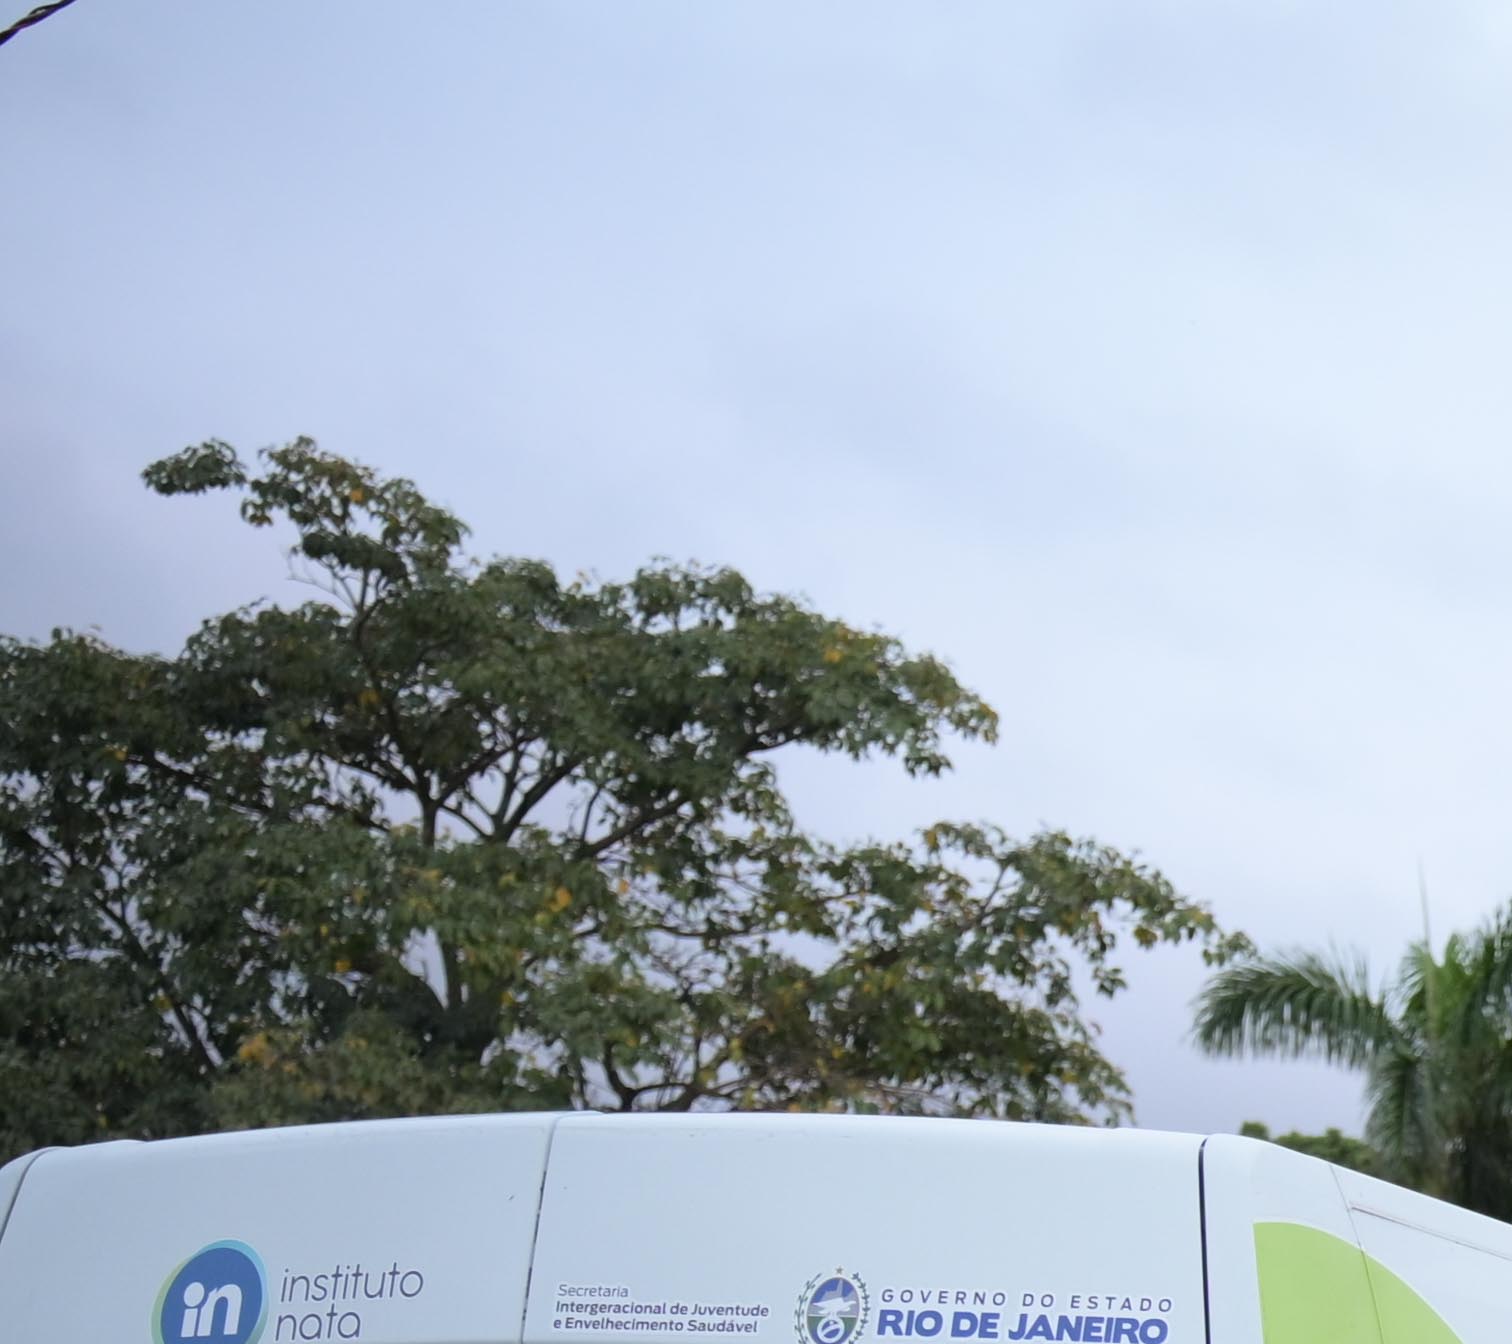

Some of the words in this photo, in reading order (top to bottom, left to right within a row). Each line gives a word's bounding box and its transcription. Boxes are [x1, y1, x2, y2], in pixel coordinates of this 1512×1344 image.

[280, 1262, 424, 1303] instituto
[557, 1285, 629, 1298] Secretaria
[555, 1300, 667, 1316] Intergeracional
[670, 1303, 688, 1315] de
[691, 1303, 770, 1317] Juventude
[881, 1288, 1006, 1306] GOVERNO
[1021, 1293, 1055, 1307] DO
[1070, 1295, 1173, 1312] ESTADO
[275, 1303, 361, 1341] nata
[553, 1318, 562, 1329] e
[565, 1317, 684, 1332] Envelhecimento
[687, 1319, 758, 1333] Saudável
[877, 1309, 944, 1337] RIO
[950, 1312, 1001, 1339] DE
